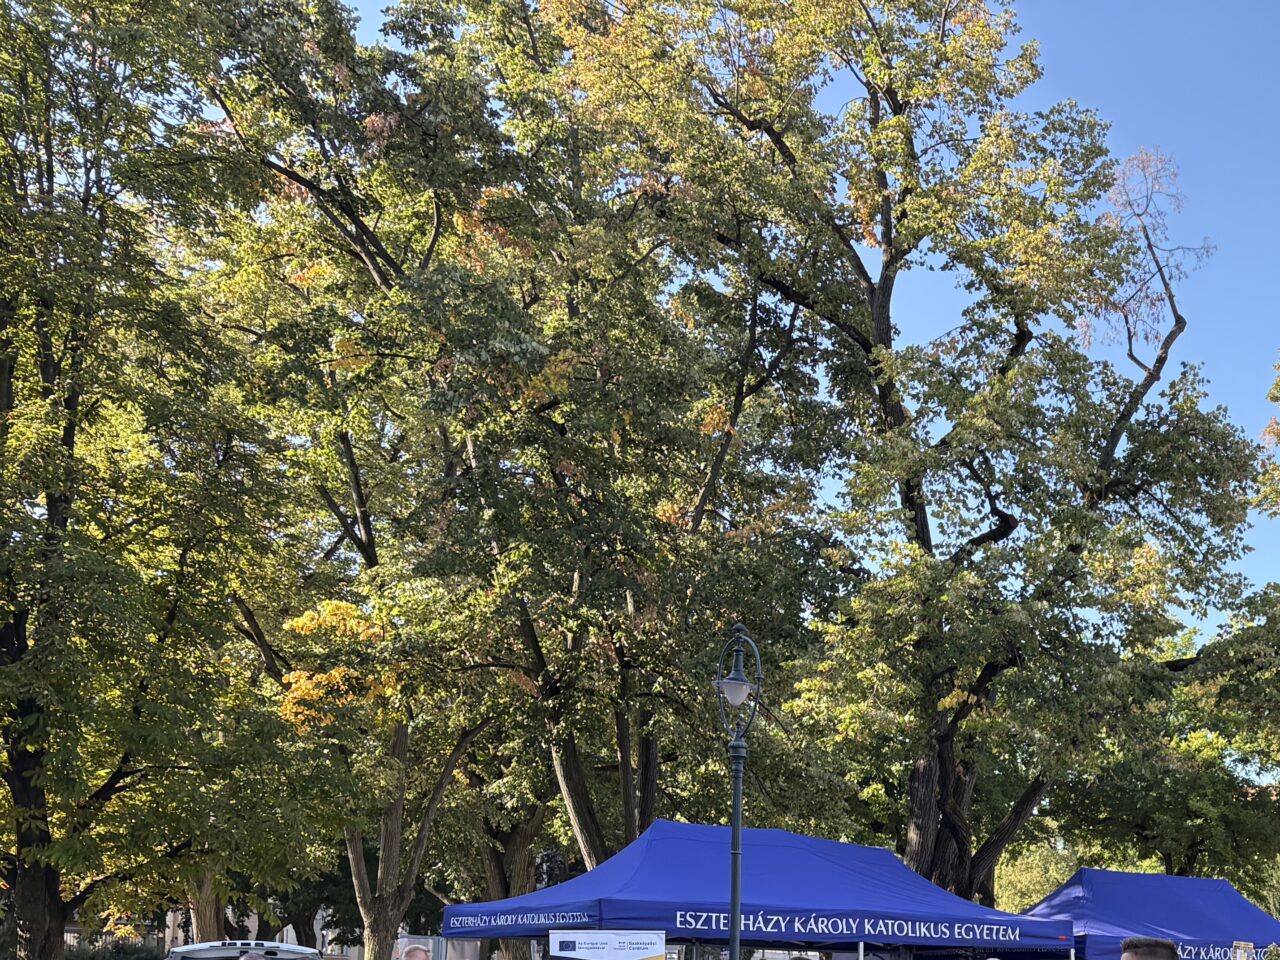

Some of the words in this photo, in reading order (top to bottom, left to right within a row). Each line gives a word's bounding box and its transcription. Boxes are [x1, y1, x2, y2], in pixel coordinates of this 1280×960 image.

[450, 914, 491, 928] ESZTERHÁZY
[491, 912, 517, 926] KÁROLY
[517, 912, 555, 924] KATOLIKUS
[676, 910, 790, 932] ESZTEHÁZY
[795, 913, 860, 935] KÁROLY
[864, 918, 950, 938] KATOLIKUS
[954, 924, 1020, 941] EGYETEM
[1200, 943, 1233, 960] KÁRO
